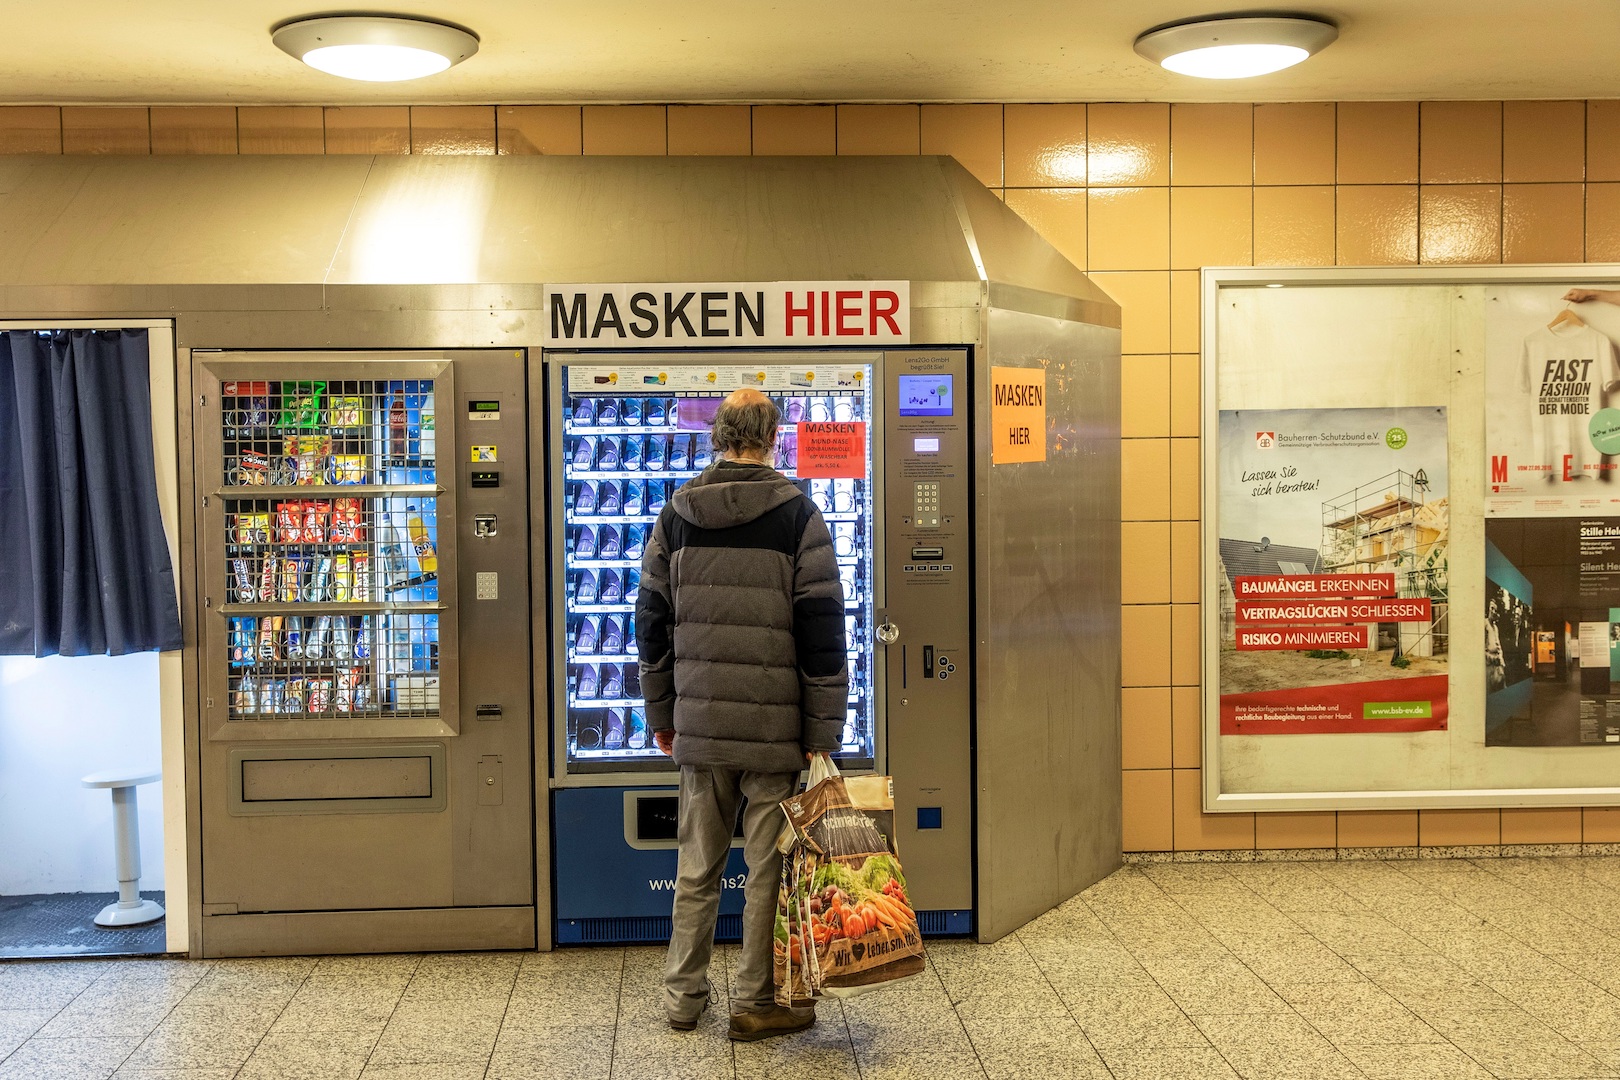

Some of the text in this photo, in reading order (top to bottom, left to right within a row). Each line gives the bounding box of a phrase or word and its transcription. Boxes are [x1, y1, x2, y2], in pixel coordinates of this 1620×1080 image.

[551, 290, 902, 339] MASKEN HIER
[1543, 359, 1593, 382] FAST
[995, 385, 1043, 406] MASKEN
[1540, 382, 1591, 396] FASHION
[1539, 403, 1590, 415] DER MODE
[805, 423, 855, 433] MASKEN
[1010, 427, 1031, 445] HIER
[1278, 432, 1380, 442] Bauherren-Schutzbund e.V.
[1241, 465, 1297, 482] Lassen Sie
[1492, 456, 1507, 482] M
[1563, 455, 1573, 481] E
[1251, 479, 1320, 497] sich beraten!
[1580, 527, 1603, 536] Stille
[1580, 562, 1605, 571] Silent
[1242, 579, 1389, 593] BAUMÄNGEL ERKENNEN
[1242, 604, 1424, 619] VERTRAGSLÜCKEN SCHLIESSEN
[1242, 632, 1360, 645] RISIKO MINIMIEREN
[1248, 705, 1295, 713] bedarfsgerechte
[1296, 704, 1326, 712] technische
[1372, 707, 1424, 715] www.bsb-ev.de
[1263, 713, 1305, 722] Baubegleitung
[1335, 712, 1353, 720] Hand.
[834, 948, 851, 966] Wir
